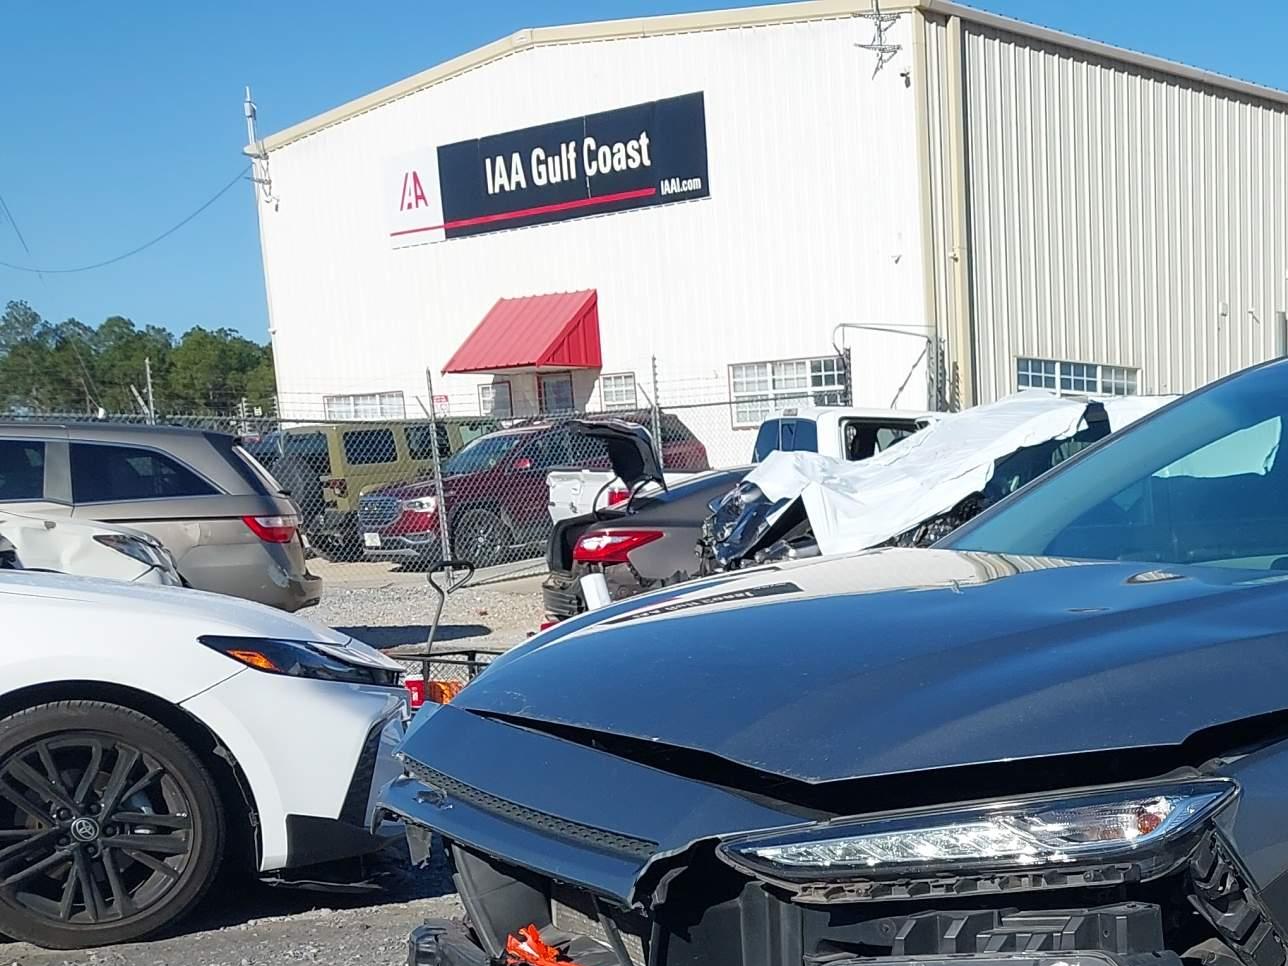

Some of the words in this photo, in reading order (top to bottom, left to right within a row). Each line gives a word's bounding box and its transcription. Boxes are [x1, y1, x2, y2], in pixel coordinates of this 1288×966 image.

[485, 152, 527, 195] IAA
[531, 140, 577, 186] Gulf
[583, 130, 651, 177] Coast
